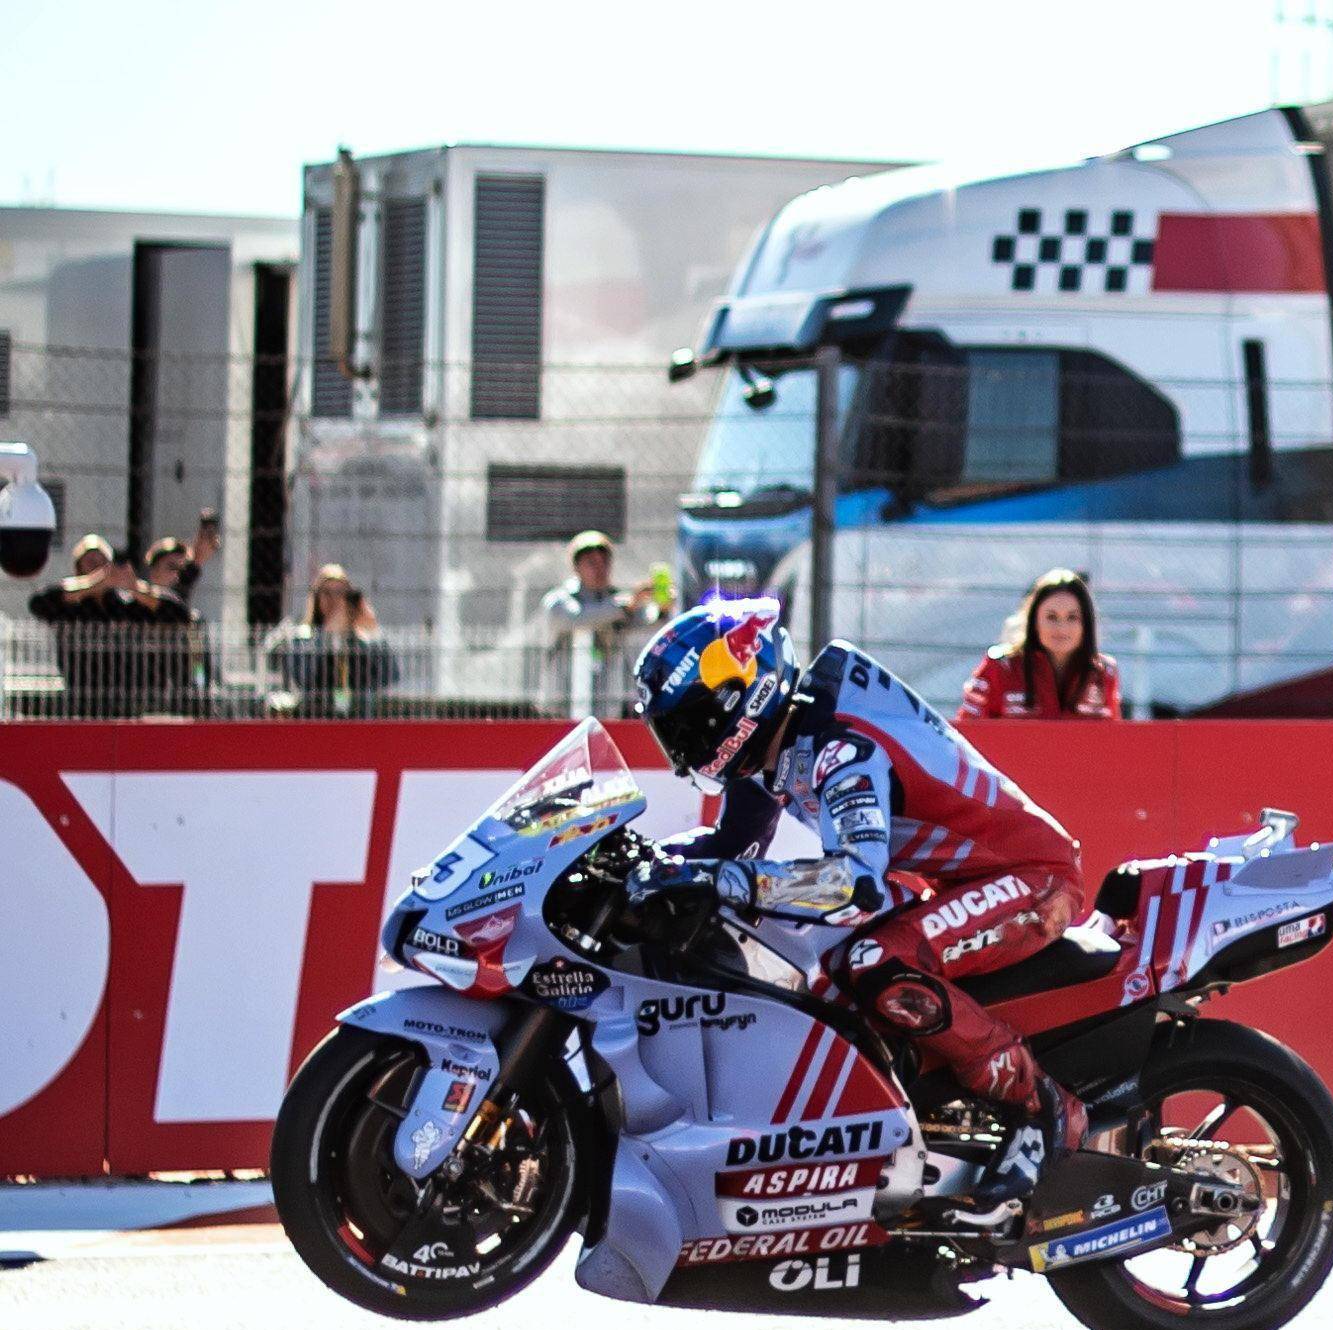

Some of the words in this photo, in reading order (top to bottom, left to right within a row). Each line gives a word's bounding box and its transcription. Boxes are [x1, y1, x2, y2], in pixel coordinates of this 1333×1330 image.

[749, 679, 776, 712] SHOEI
[479, 858, 544, 890] Unibat
[532, 970, 594, 986] Estrella
[637, 992, 726, 1037] guru
[725, 1120, 884, 1166] DUCATI
[743, 1162, 859, 1197] ASPIRA
[761, 1198, 858, 1219] MODULA
[820, 1224, 869, 1250] OIL
[1073, 1219, 1158, 1256] MICHELIN
[381, 1252, 481, 1280] BATTIPAV
[768, 1253, 862, 1291] OLI
